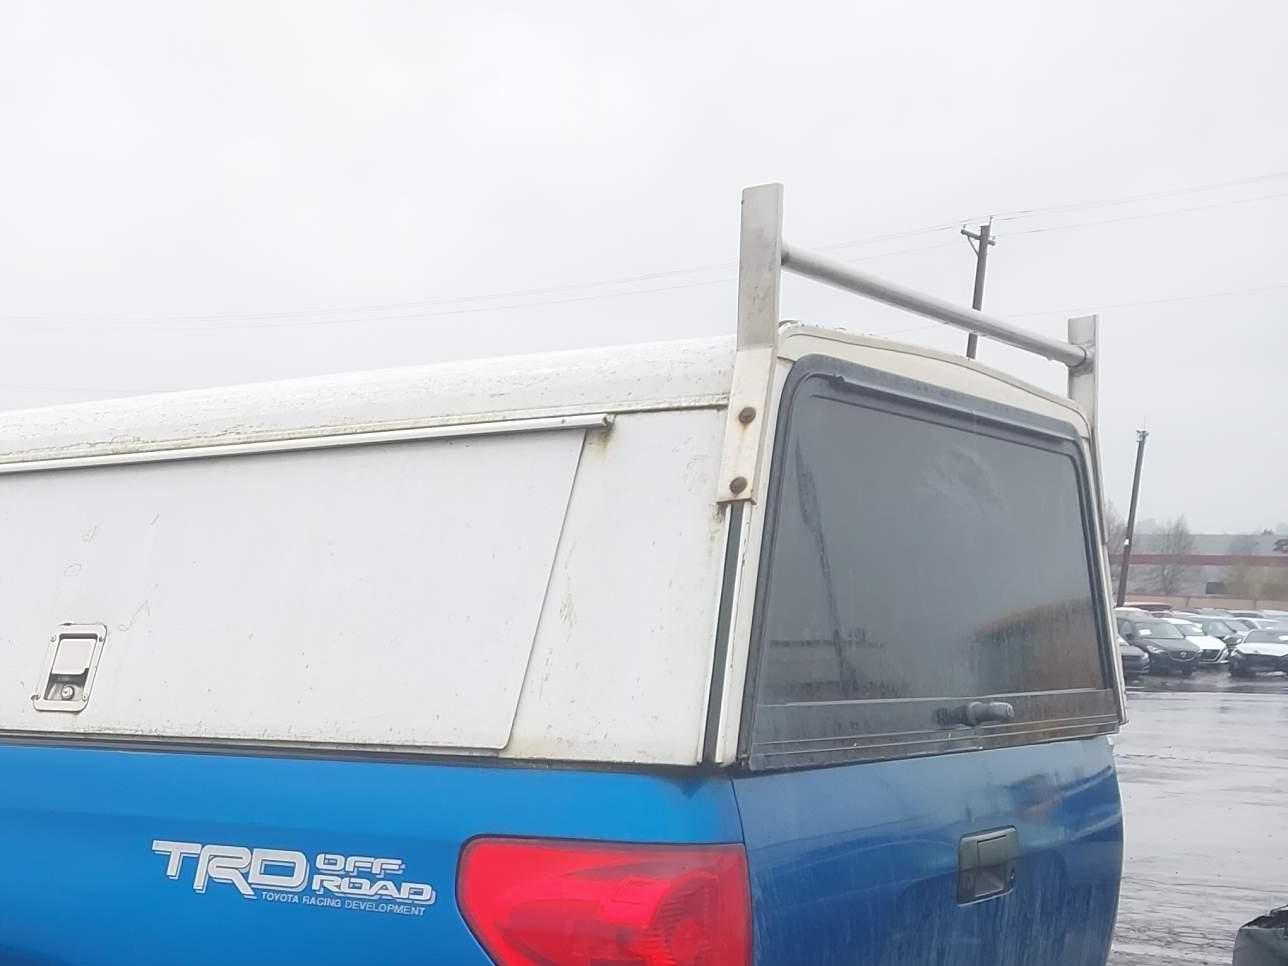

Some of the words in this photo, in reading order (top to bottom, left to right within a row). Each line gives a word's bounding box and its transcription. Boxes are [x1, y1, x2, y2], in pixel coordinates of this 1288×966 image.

[152, 839, 309, 900] TRD
[315, 852, 406, 877] OFF
[311, 874, 436, 905] ROAD
[261, 891, 300, 904] TOYOTA
[302, 895, 342, 908] RACING
[344, 899, 426, 917] DEVELOPMENT
